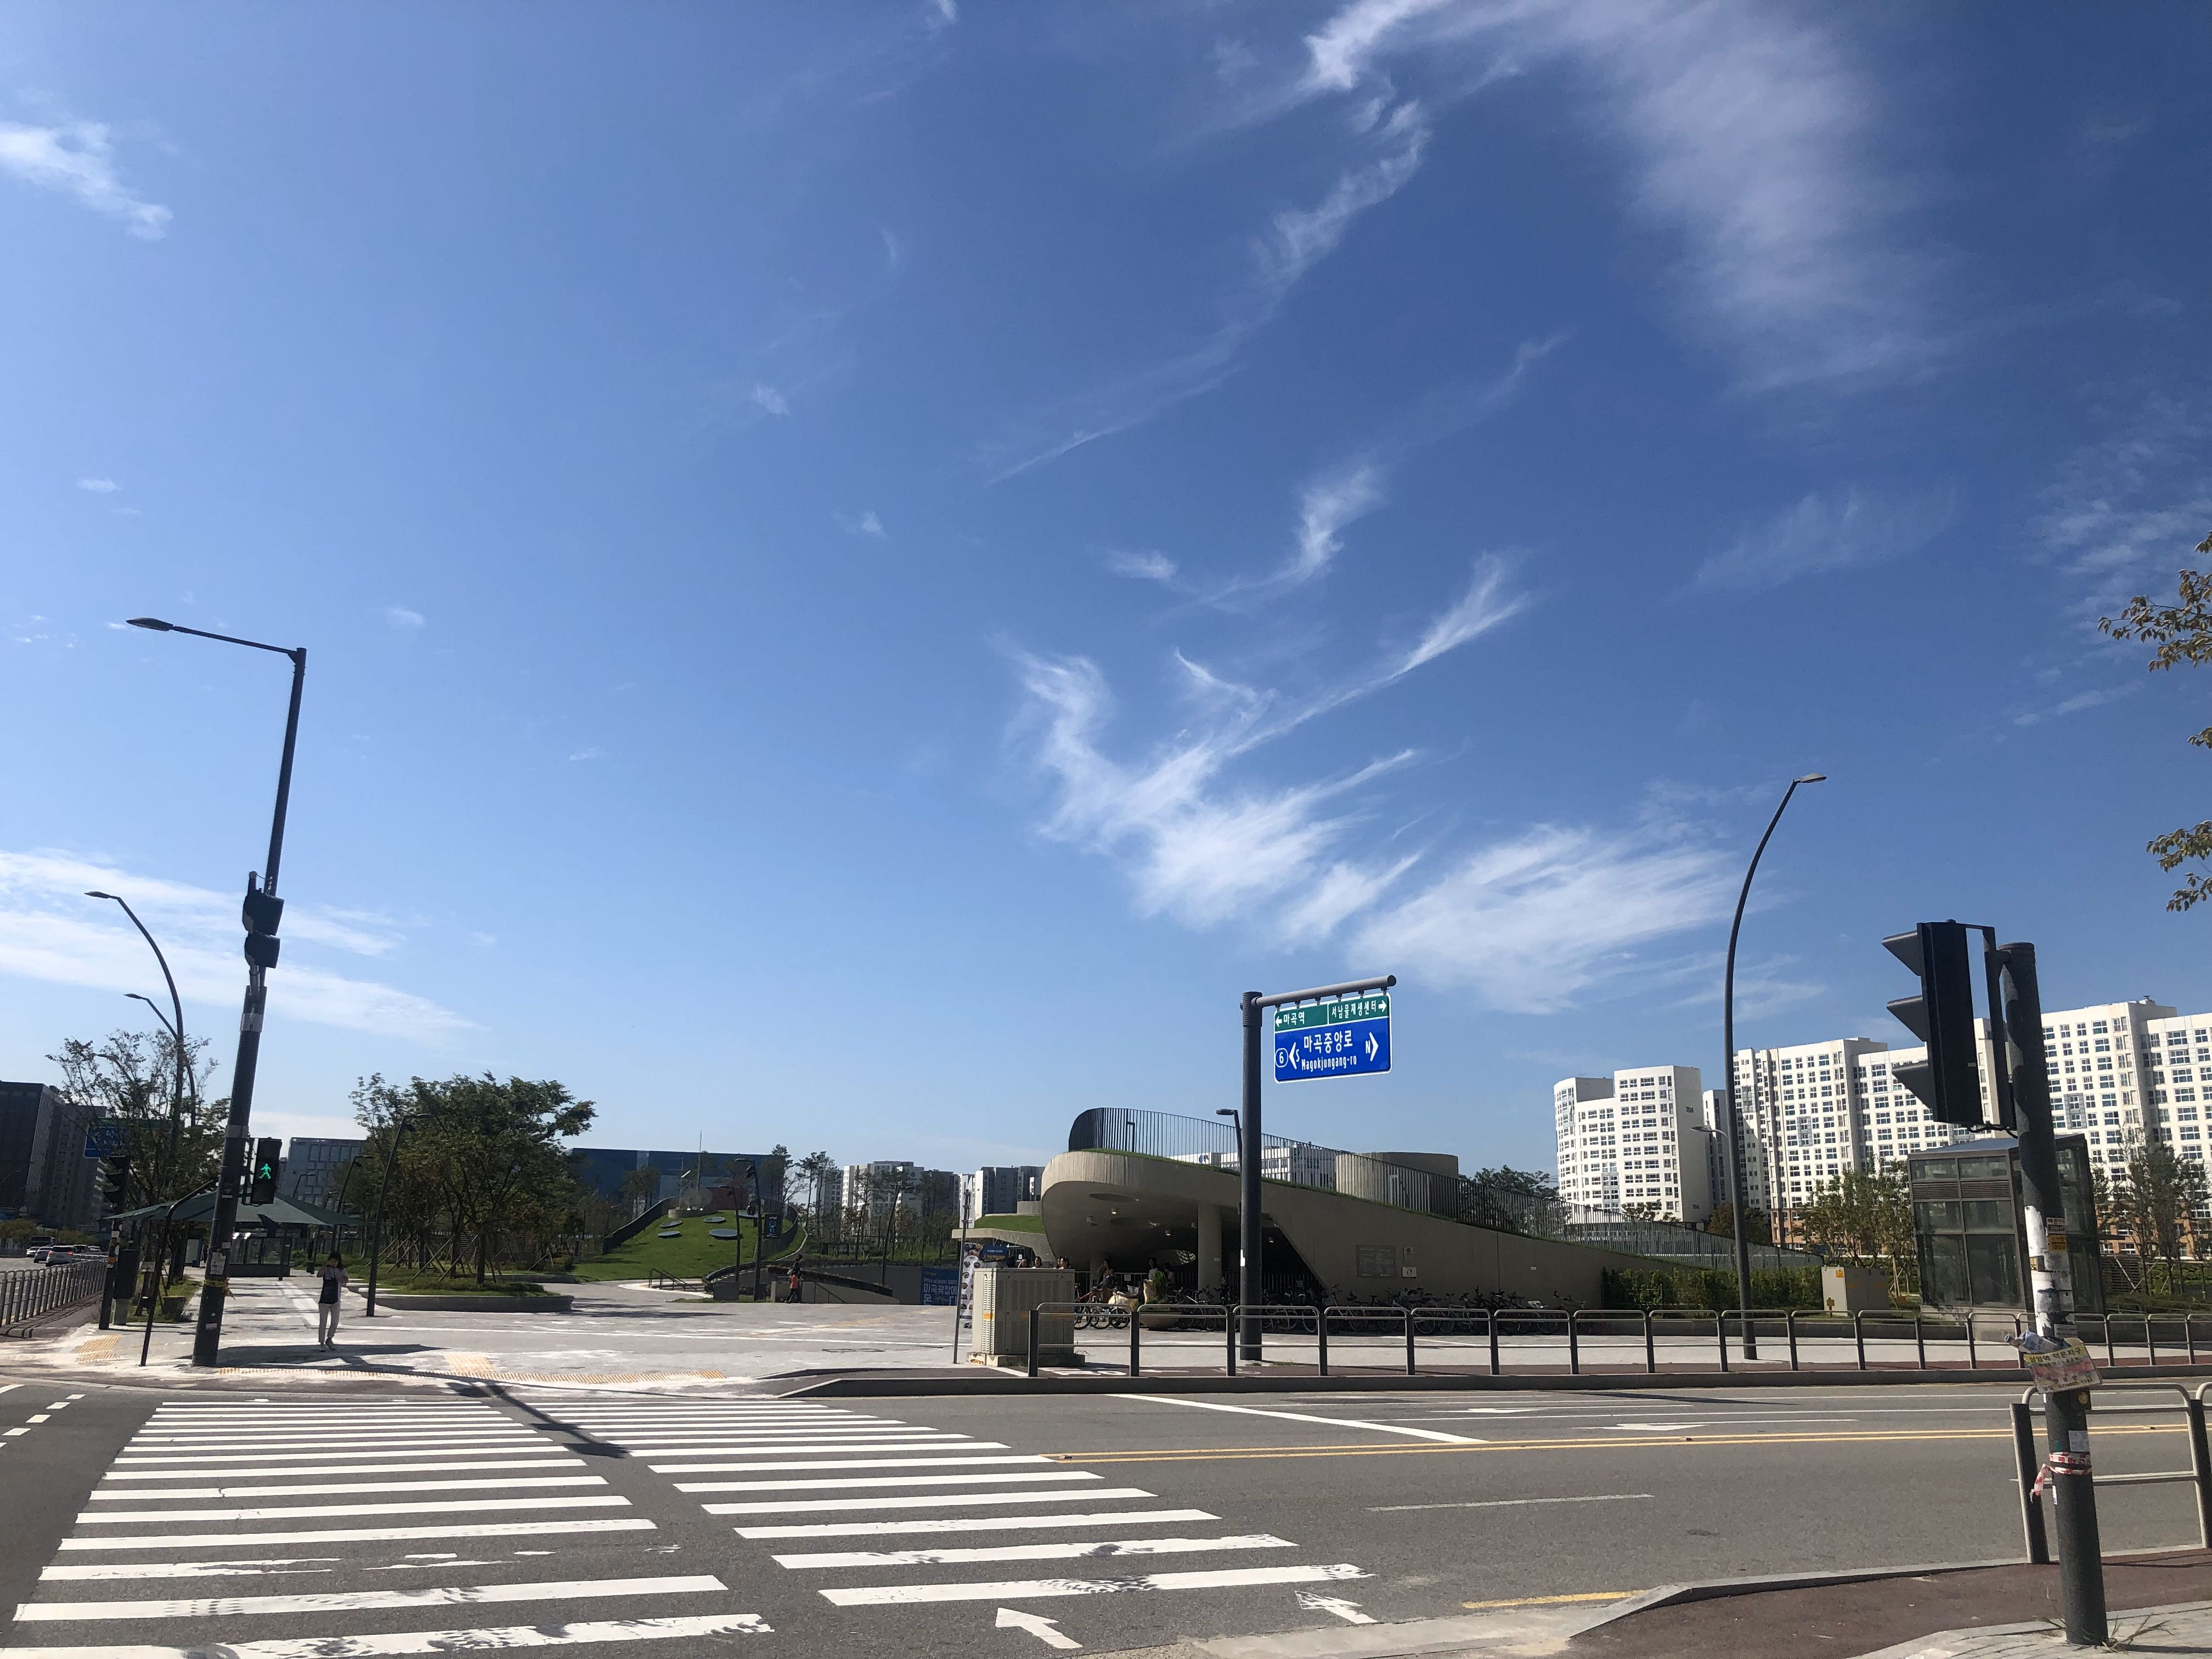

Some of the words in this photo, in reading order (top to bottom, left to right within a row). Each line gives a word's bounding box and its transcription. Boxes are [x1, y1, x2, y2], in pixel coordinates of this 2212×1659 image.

[1331, 1000, 1376, 1019] 서남물재생센터
[1283, 1011, 1305, 1026] 마곡역
[1304, 1030, 1353, 1054] 마곡중앙로
[1365, 1040, 1371, 1054] N
[1279, 1051, 1284, 1064] 6
[1295, 1048, 1300, 1063] S
[1301, 1054, 1357, 1072] Magokjungang-ro
